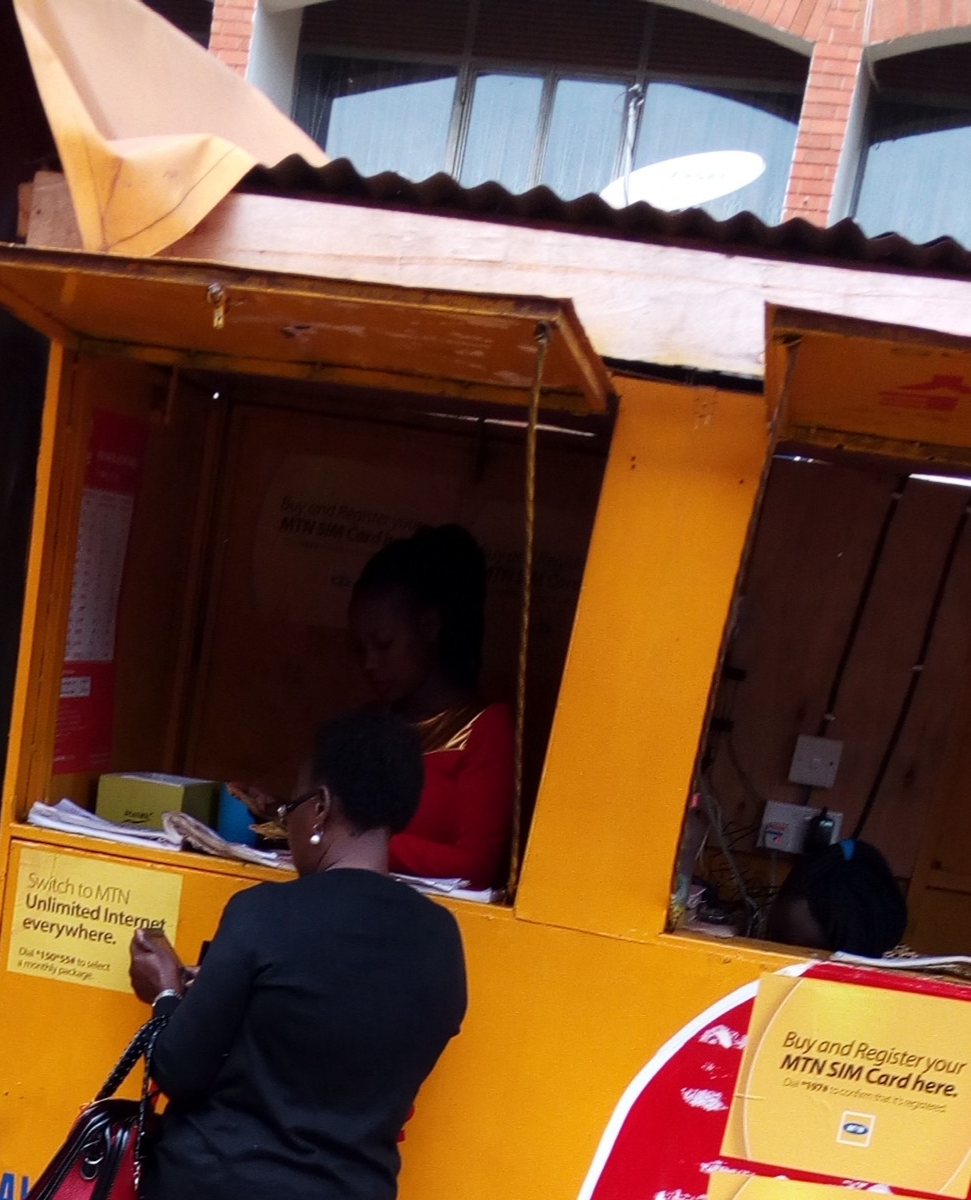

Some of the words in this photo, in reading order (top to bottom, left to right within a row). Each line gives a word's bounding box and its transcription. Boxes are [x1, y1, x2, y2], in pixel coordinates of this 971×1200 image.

[279, 516, 315, 536] MTN
[28, 872, 74, 896] Switch
[78, 886, 93, 899] to
[95, 885, 131, 905] MTN
[26, 893, 102, 921] Unlimited
[23, 917, 117, 945] everywhere.
[24, 960, 57, 975] monthly
[77, 957, 86, 967] to
[87, 959, 110, 971] select
[783, 1031, 817, 1055] Buy
[818, 1040, 856, 1056] and
[852, 1042, 925, 1068] Register
[920, 1057, 968, 1075] your
[779, 1054, 827, 1075] MTN
[826, 1061, 865, 1082] SIM
[865, 1068, 913, 1089] Card
[911, 1074, 959, 1098] here.
